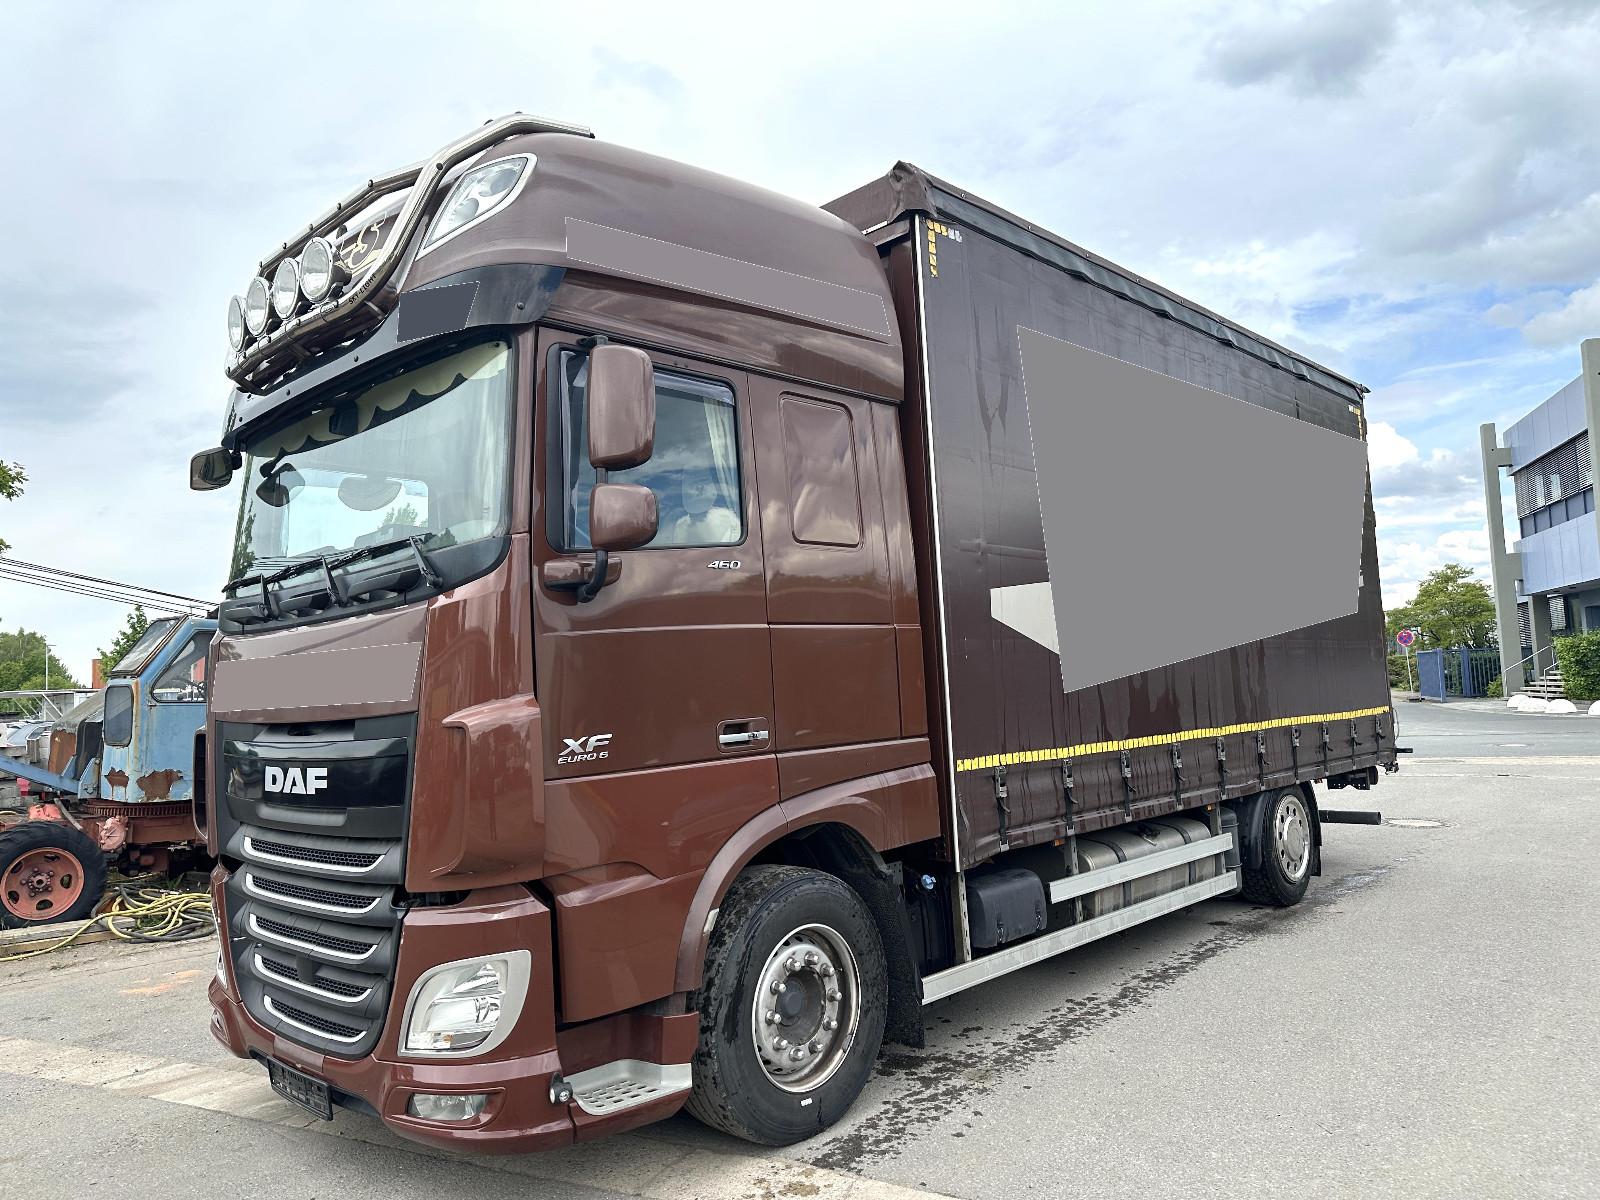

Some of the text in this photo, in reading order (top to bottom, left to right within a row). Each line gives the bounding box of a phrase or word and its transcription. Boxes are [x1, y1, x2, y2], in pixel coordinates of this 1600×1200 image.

[348, 273, 377, 305] SKY-LIGHT
[707, 560, 741, 569] 460
[558, 733, 613, 756] XF
[557, 751, 609, 765] EURO 6
[264, 765, 328, 795] DAF
